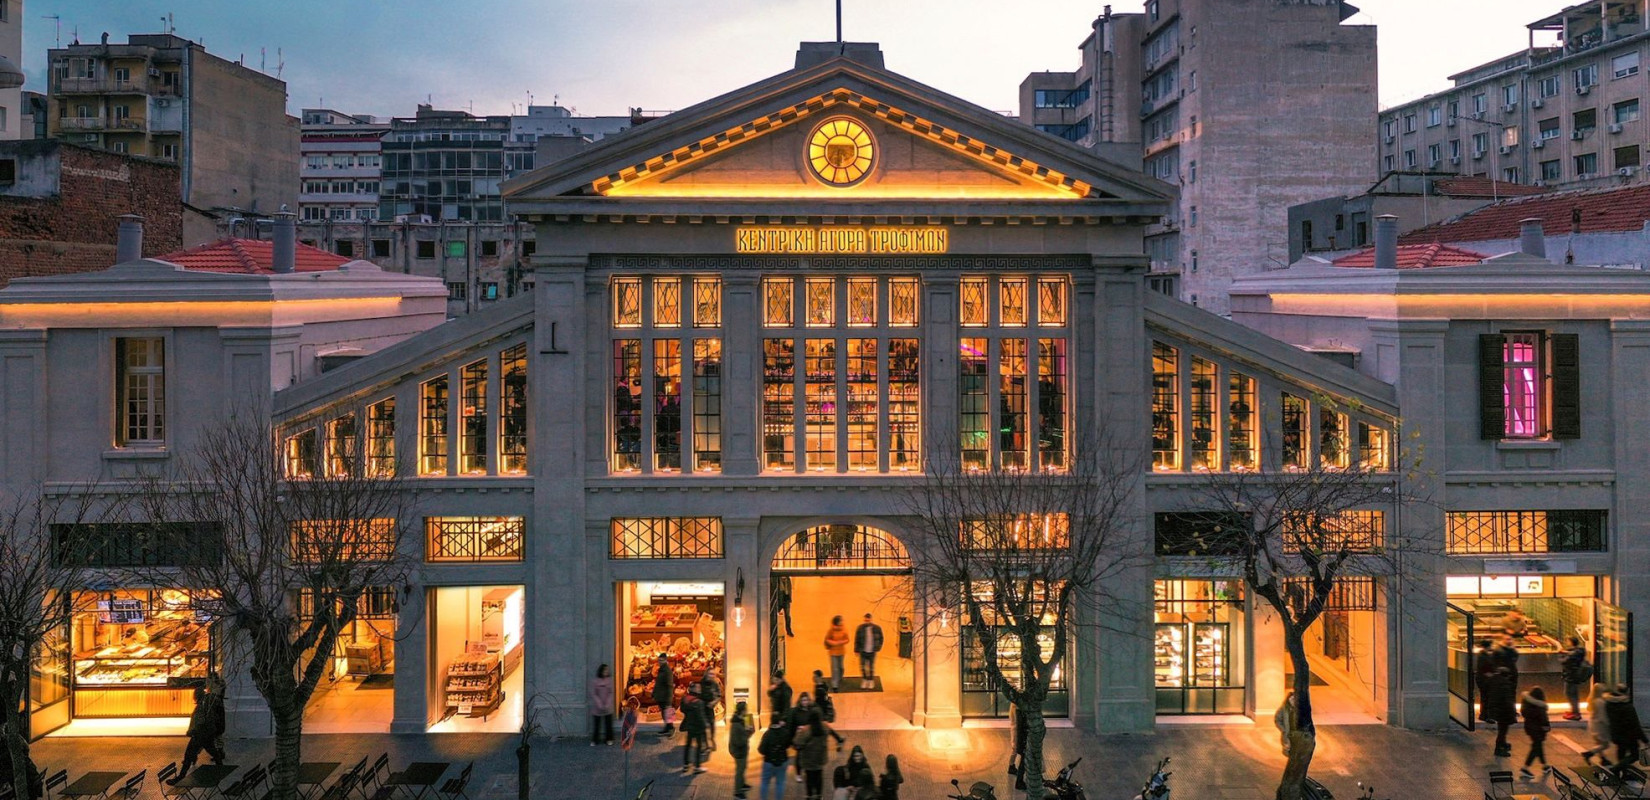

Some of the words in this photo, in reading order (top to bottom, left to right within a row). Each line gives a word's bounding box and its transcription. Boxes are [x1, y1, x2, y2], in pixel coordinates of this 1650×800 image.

[737, 229, 815, 252] ΚΕΝΤΡΙΚΗ
[819, 229, 866, 252] ΑΓΟΡΑ
[869, 229, 946, 252] ΤΡΟΦΙΜΩΝ
